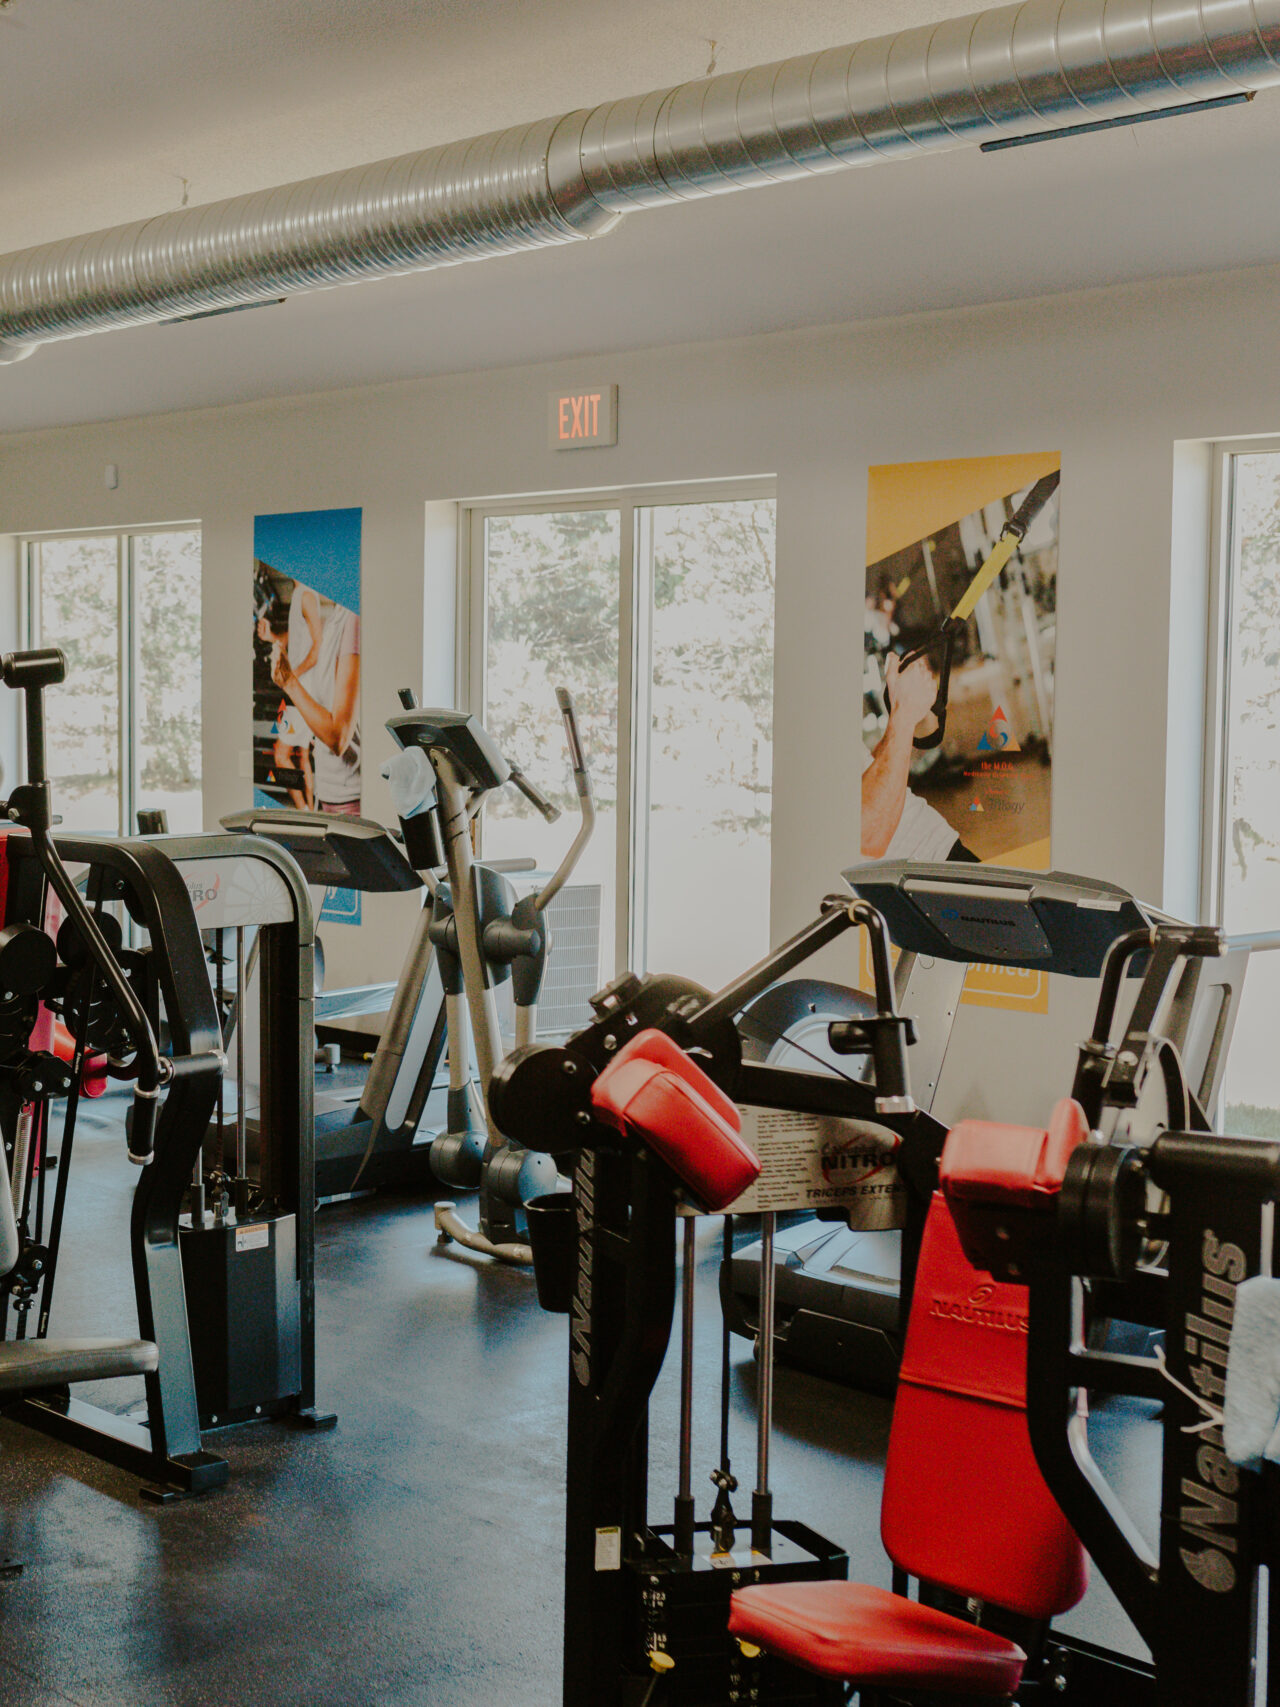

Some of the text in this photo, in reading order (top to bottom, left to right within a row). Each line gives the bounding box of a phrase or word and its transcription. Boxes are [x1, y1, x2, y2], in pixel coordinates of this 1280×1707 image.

[558, 394, 601, 440] EXIT
[822, 1151, 894, 1170] NITRO
[572, 1148, 596, 1357] Nautilu
